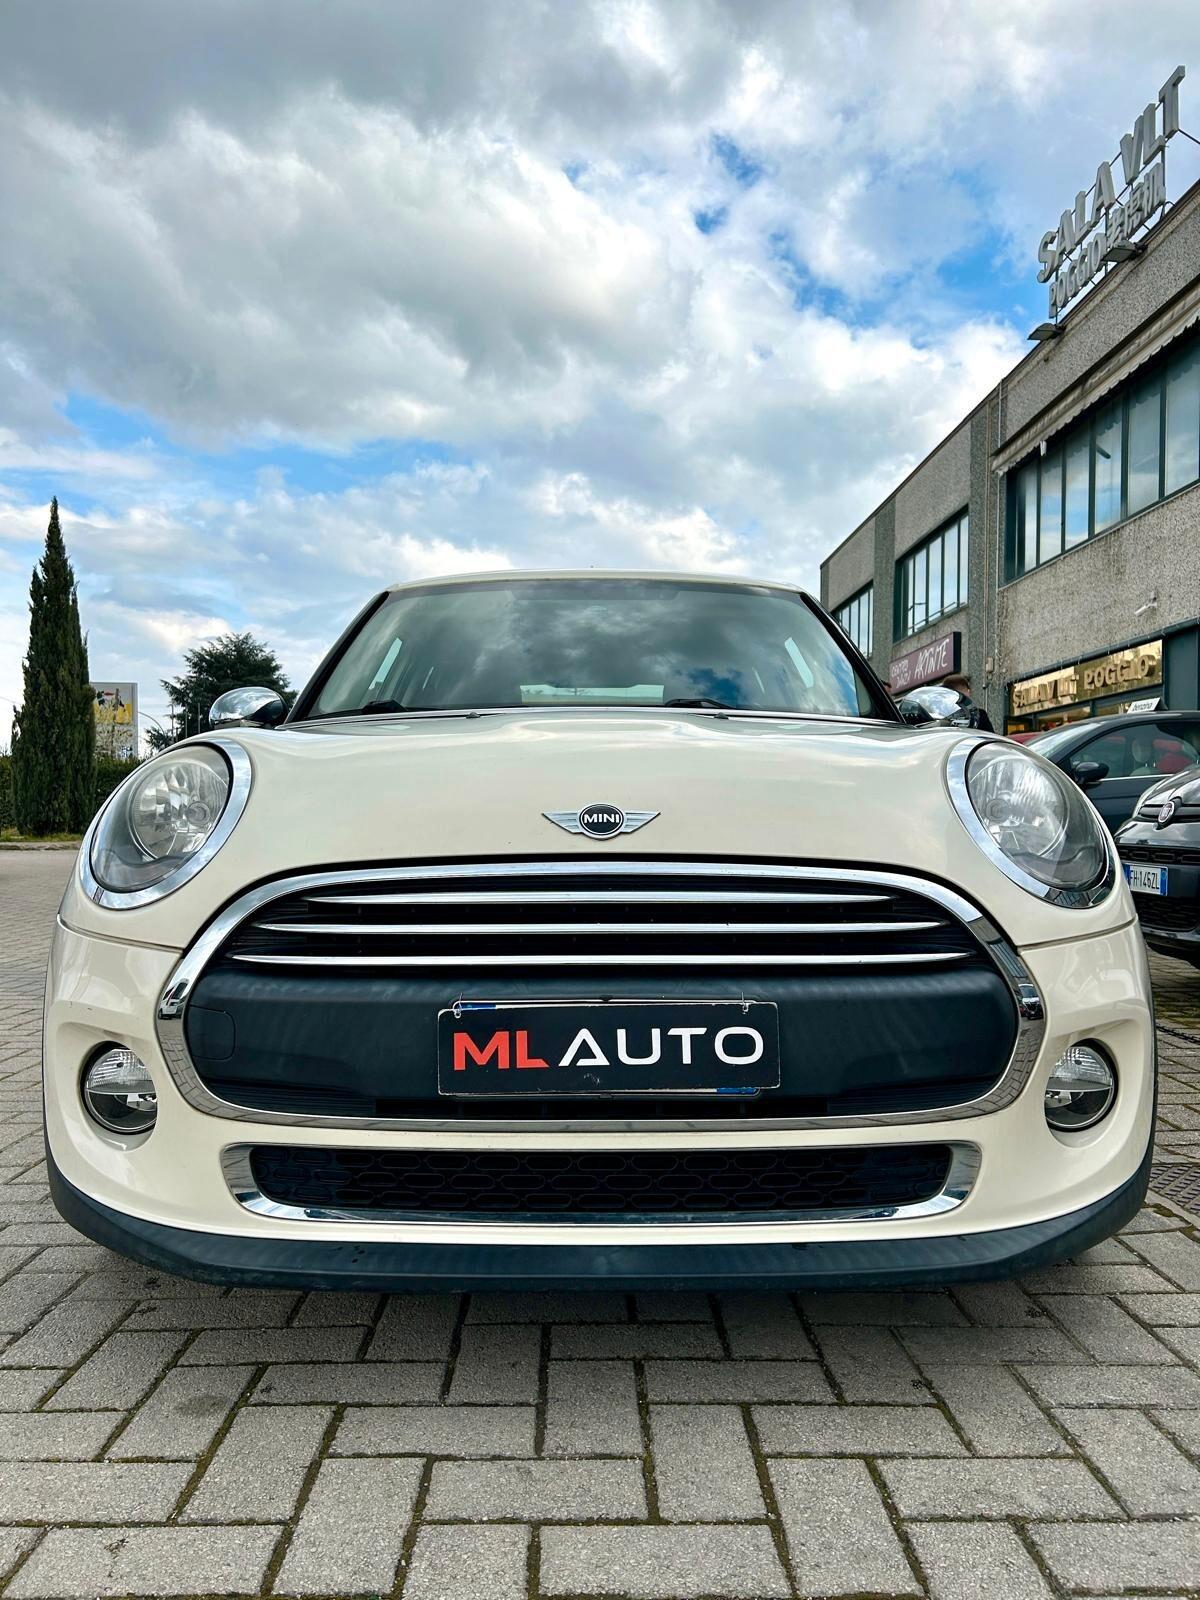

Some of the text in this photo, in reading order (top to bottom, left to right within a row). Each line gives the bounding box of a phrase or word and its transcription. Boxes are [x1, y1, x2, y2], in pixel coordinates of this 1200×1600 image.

[1037, 65, 1186, 283] SALA VLT
[1049, 232, 1107, 318] POGGIO
[1084, 655, 1155, 690] POGGIO
[583, 813, 620, 823] MINI
[453, 1026, 764, 1070] ML AUTO
